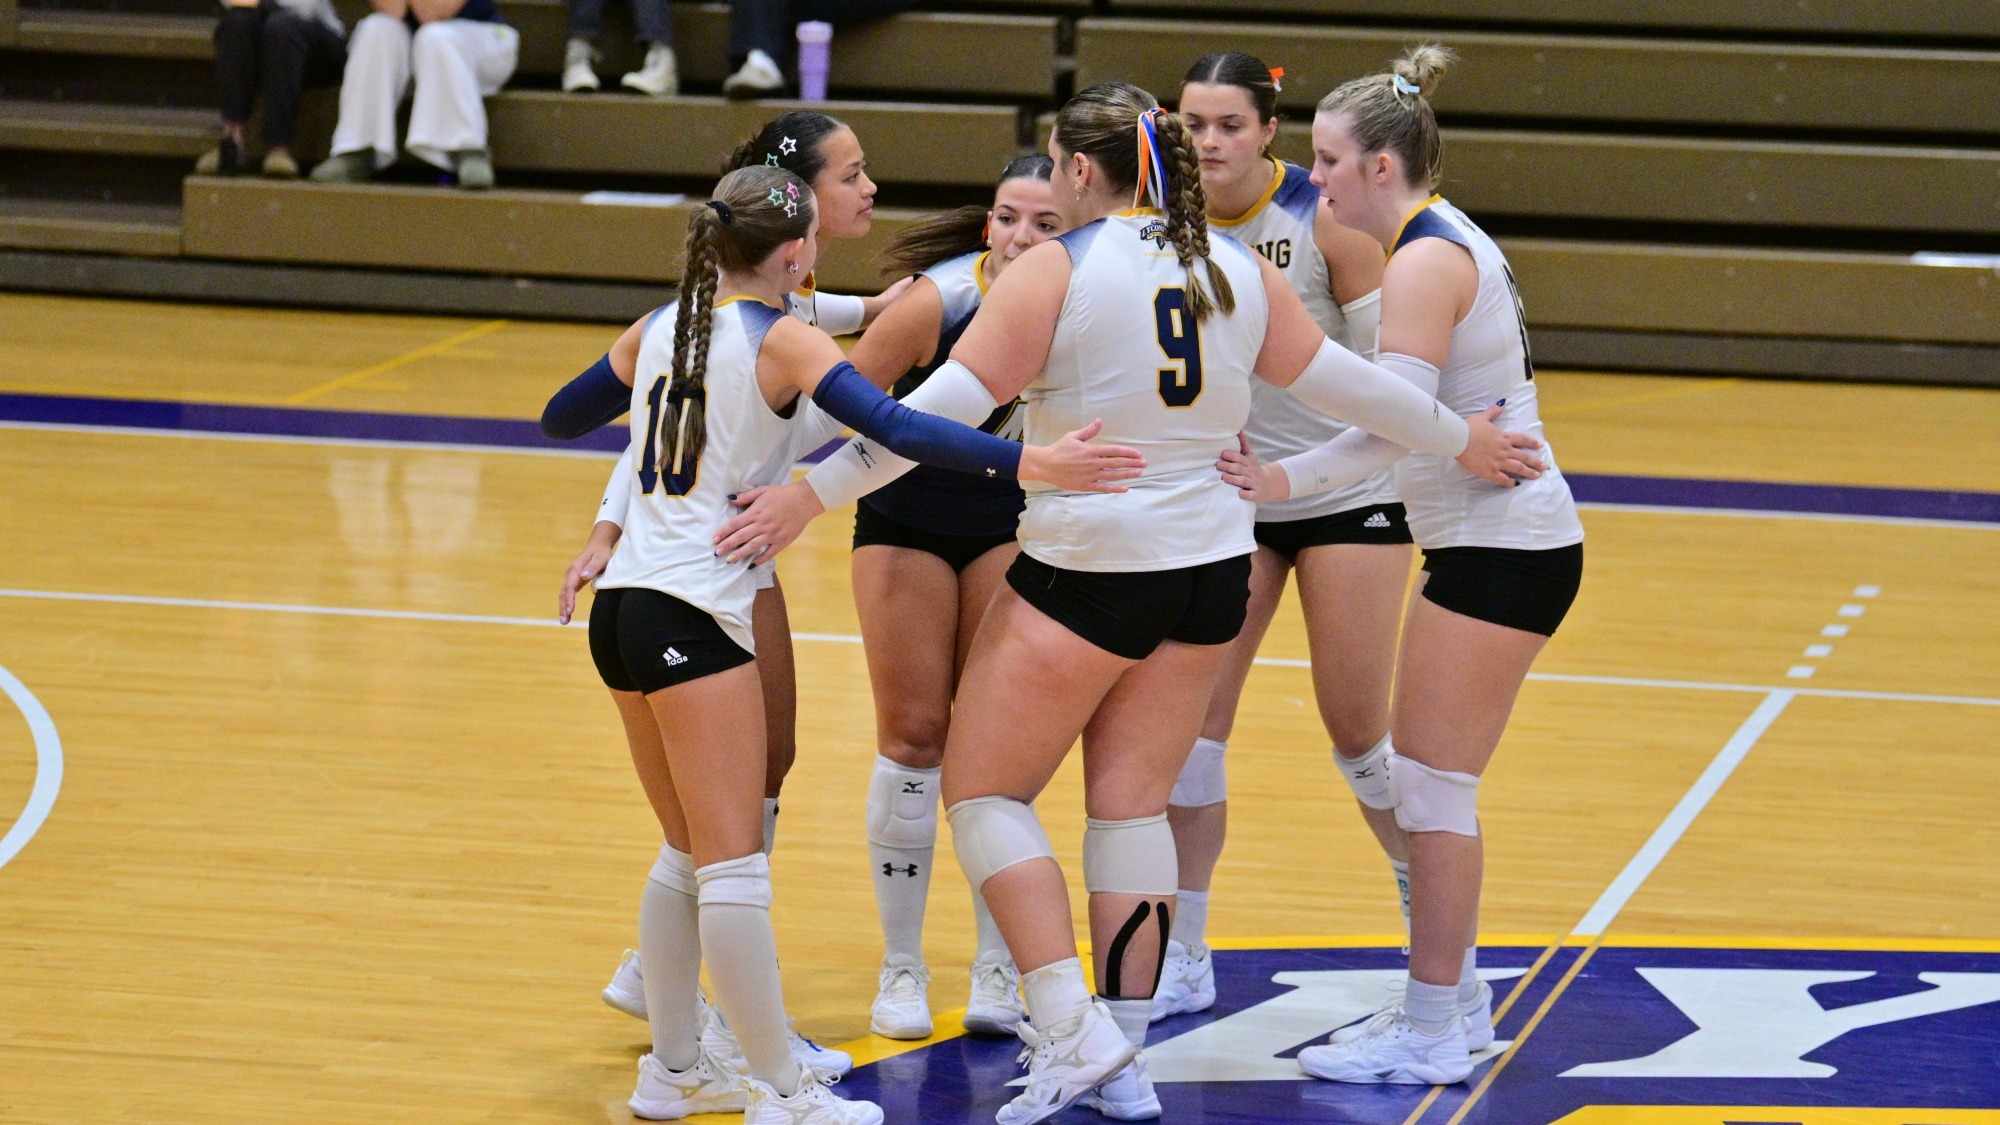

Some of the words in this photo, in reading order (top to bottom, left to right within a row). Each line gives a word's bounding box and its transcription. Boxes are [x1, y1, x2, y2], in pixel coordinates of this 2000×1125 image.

[1250, 238, 1292, 269] NG
[1152, 285, 1204, 409] 9
[638, 372, 709, 498] 10
[1363, 520, 1391, 528] adidas
